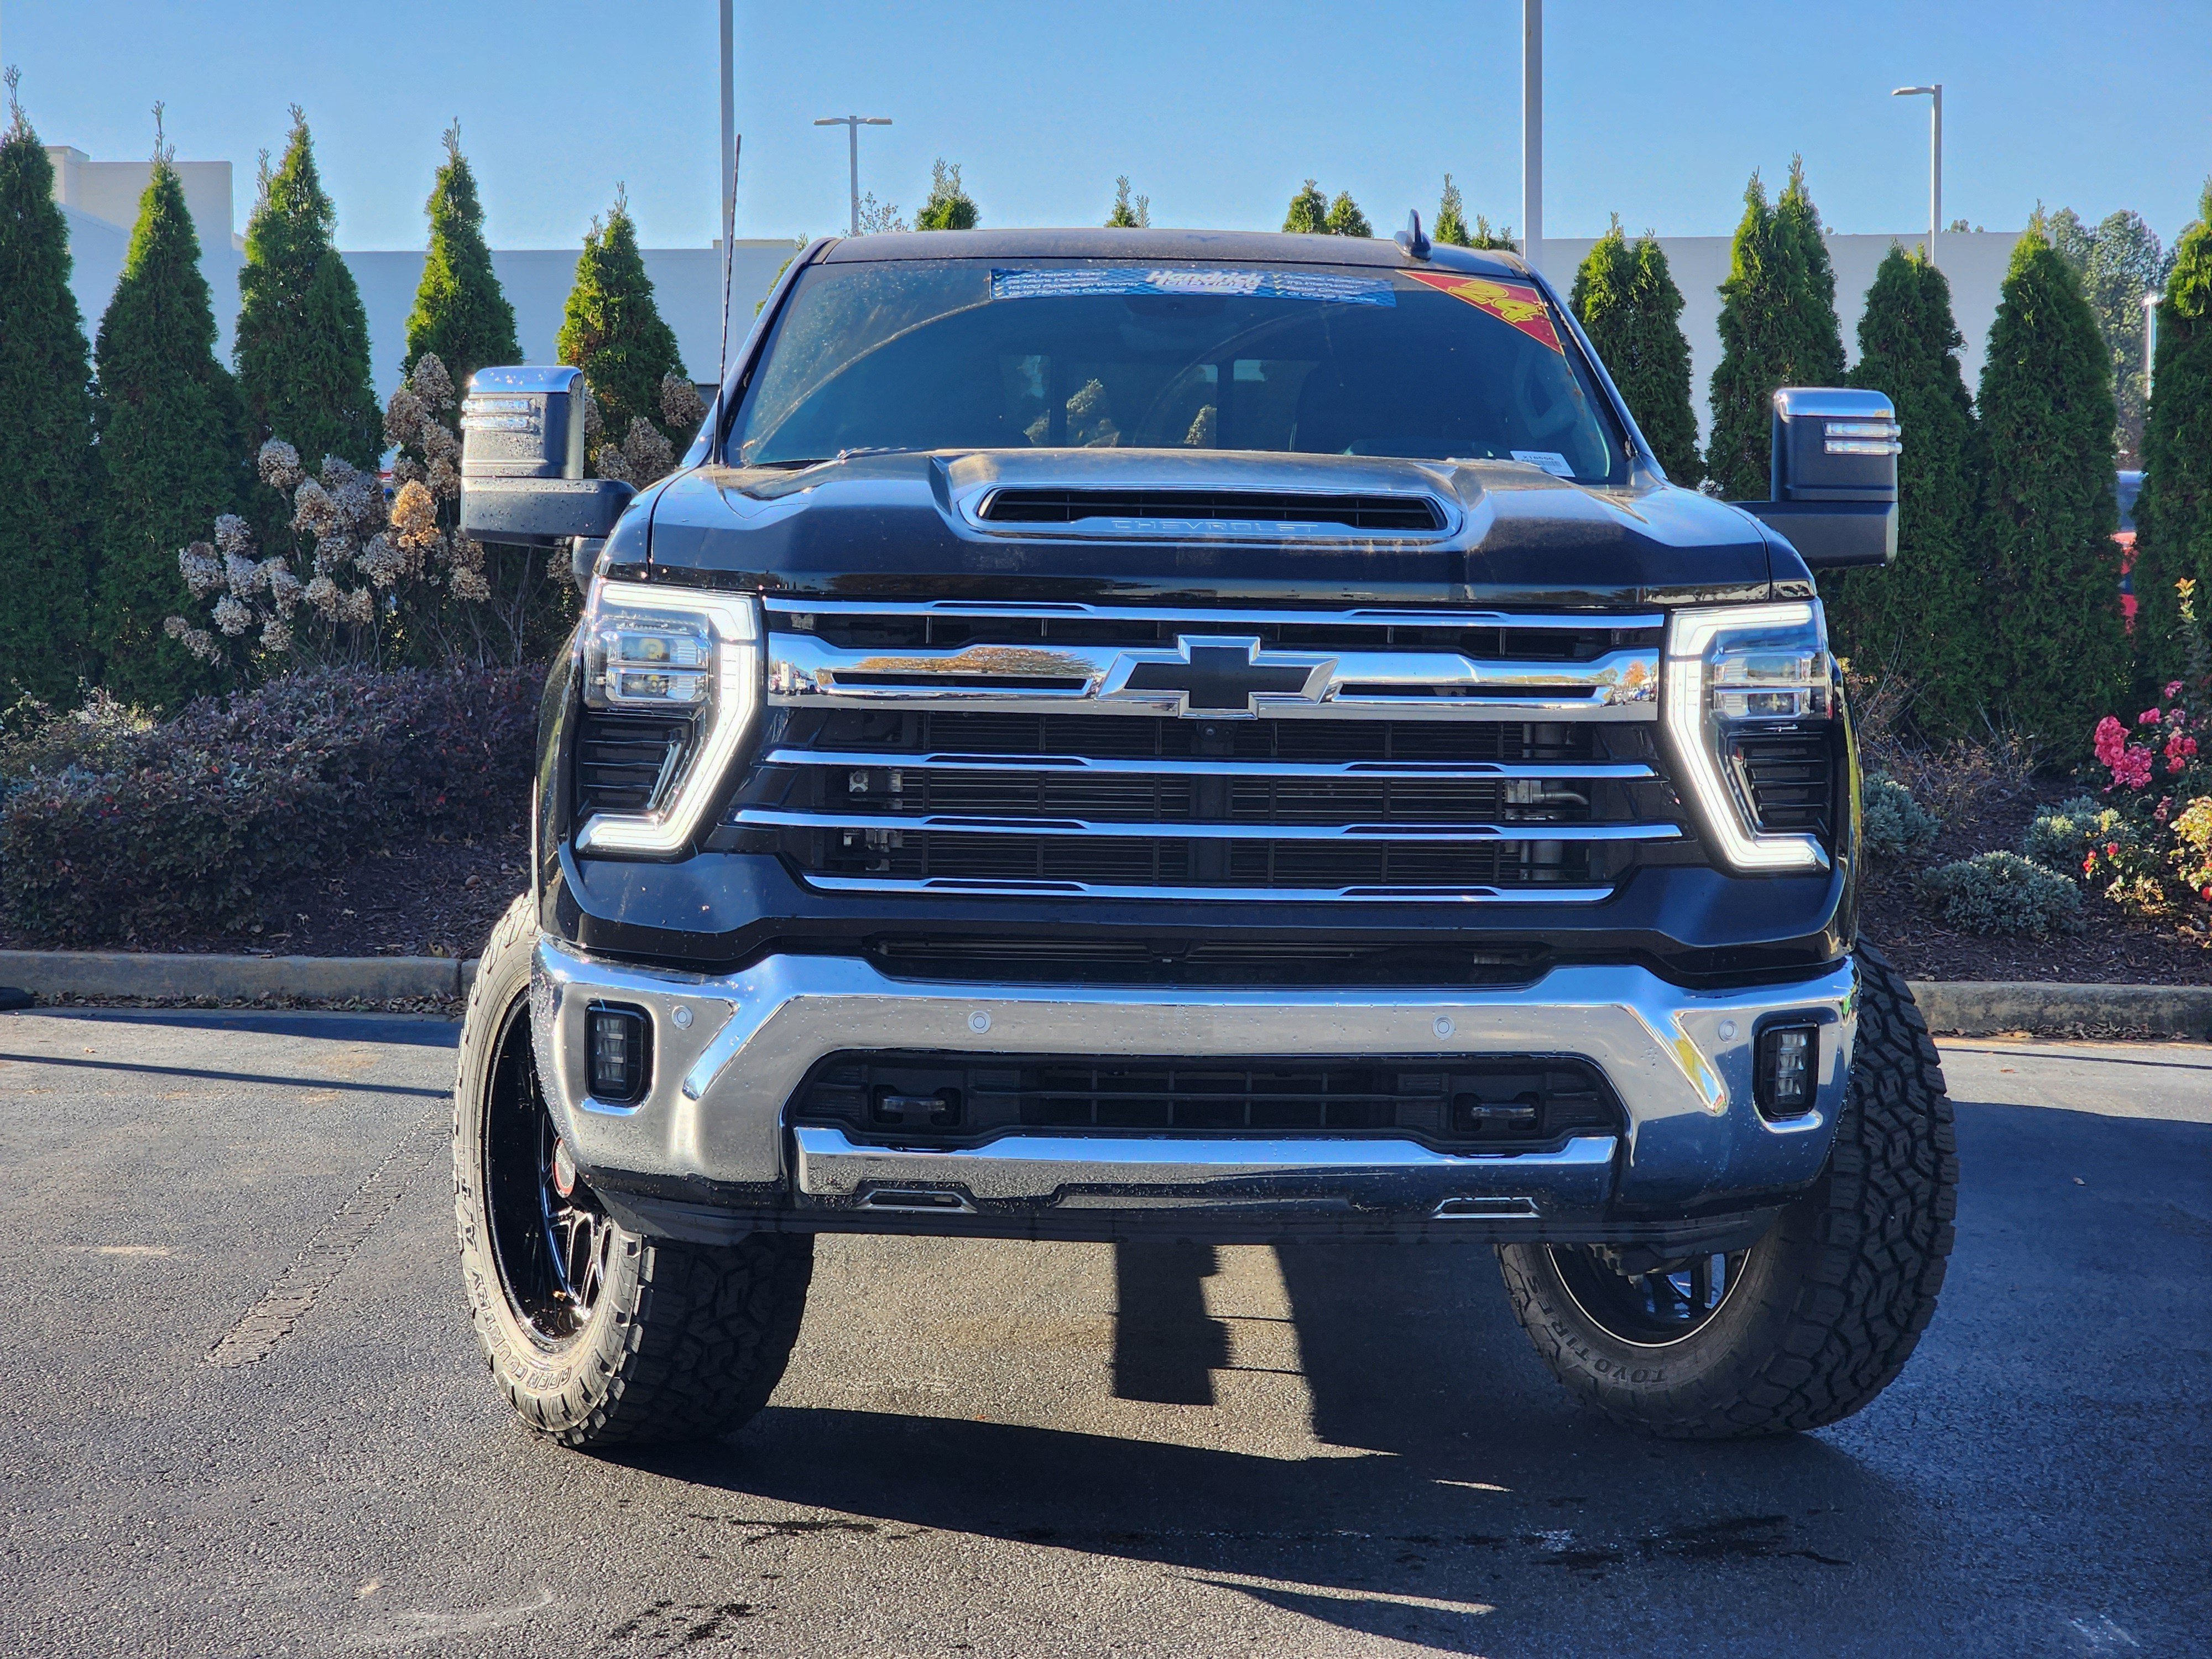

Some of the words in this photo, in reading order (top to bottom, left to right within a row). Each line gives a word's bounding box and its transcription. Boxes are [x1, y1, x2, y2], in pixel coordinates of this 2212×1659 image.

[1145, 270, 1265, 286] Hendrick
[1447, 280, 1542, 323] 24
[1111, 520, 1318, 533] CHEVROLET
[471, 1266, 528, 1381] COUNTRY
[1526, 1275, 1590, 1362] TIRES
[527, 1365, 572, 1390] OPEN
[1594, 1358, 1668, 1383] TOYO
